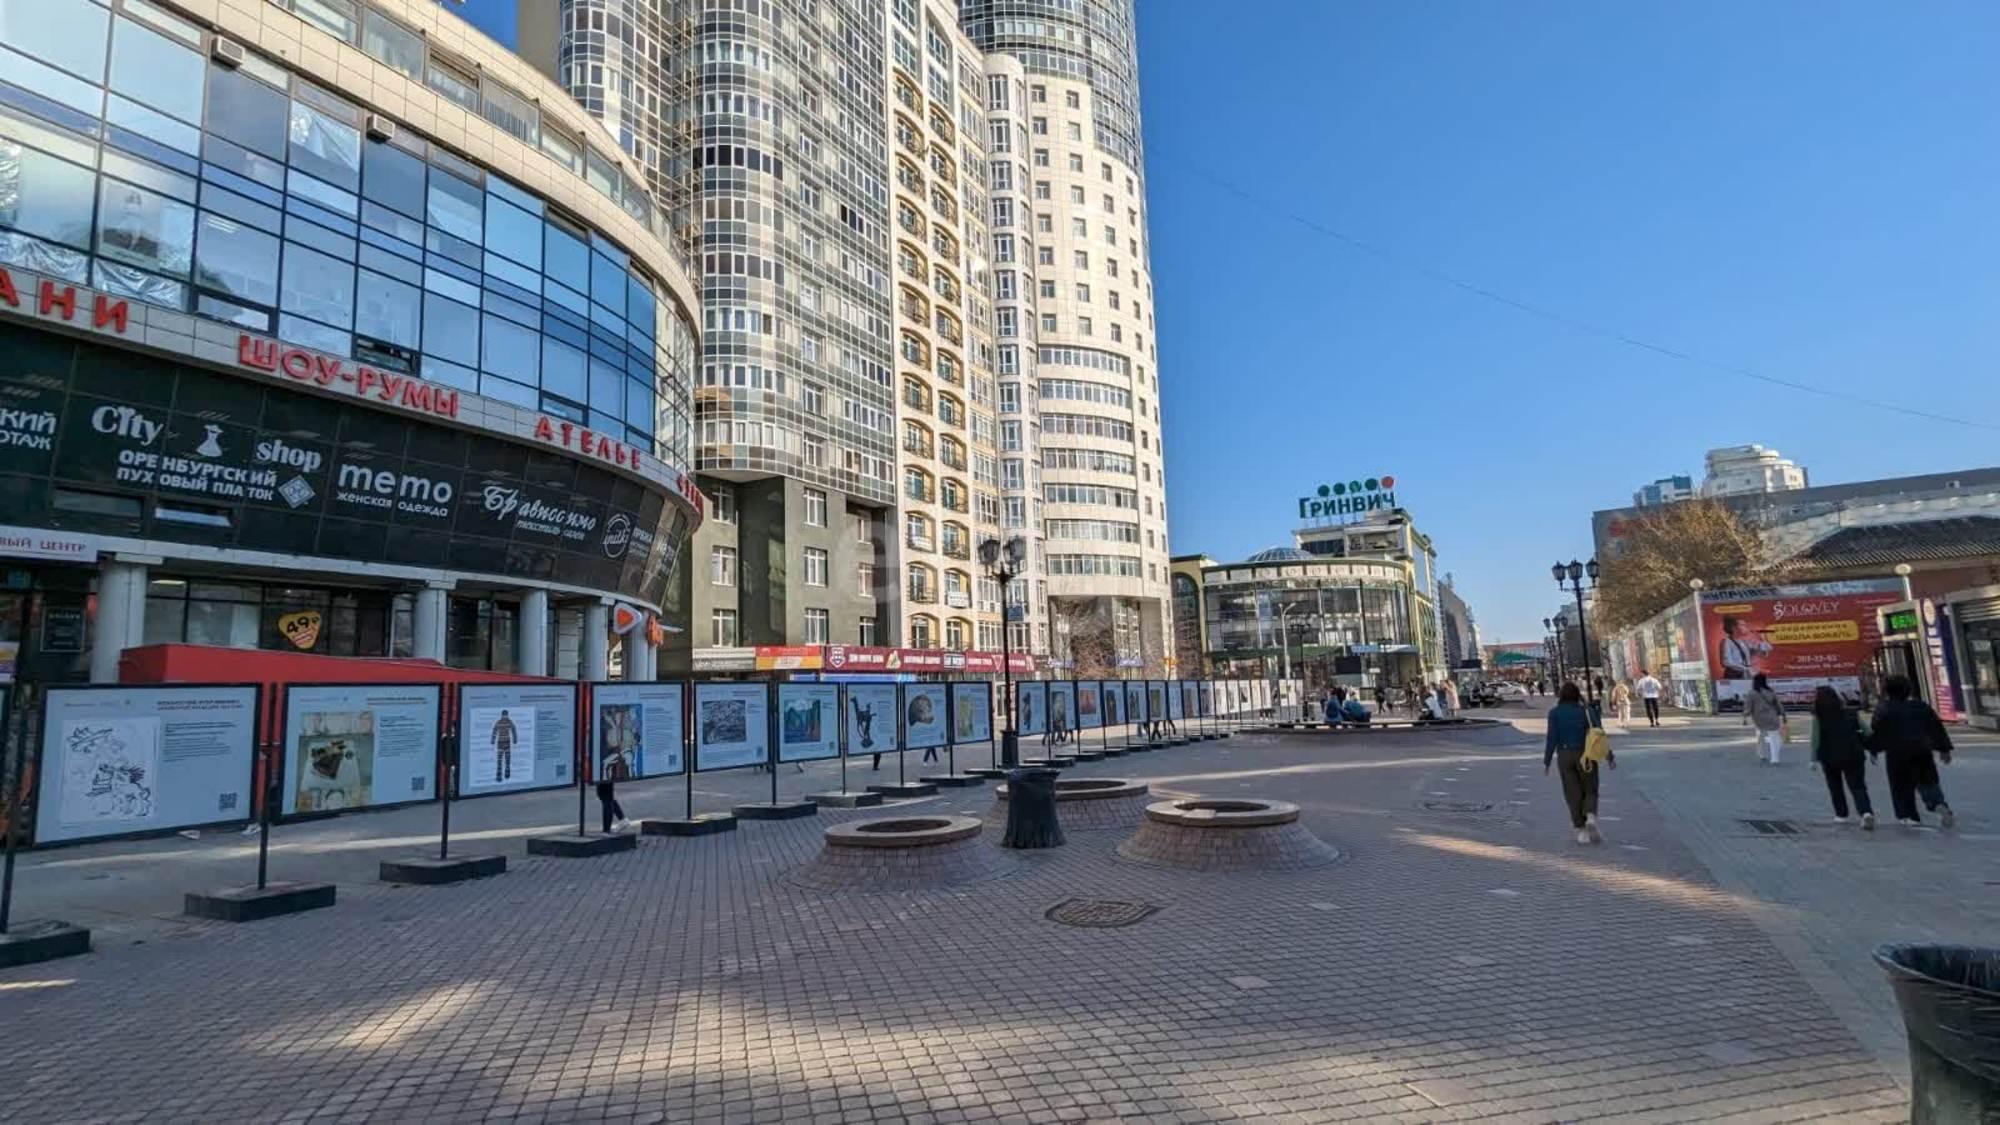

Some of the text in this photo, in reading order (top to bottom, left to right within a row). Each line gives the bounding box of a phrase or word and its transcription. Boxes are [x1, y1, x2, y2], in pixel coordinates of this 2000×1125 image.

[239, 334, 458, 418] ШОУ-РУМЫ
[256, 440, 321, 473] shop
[535, 416, 641, 470] АТЕЛЬЕ
[338, 464, 452, 503] memo
[398, 501, 448, 517] одежда
[1299, 492, 1395, 518] ГРИНВИЧ
